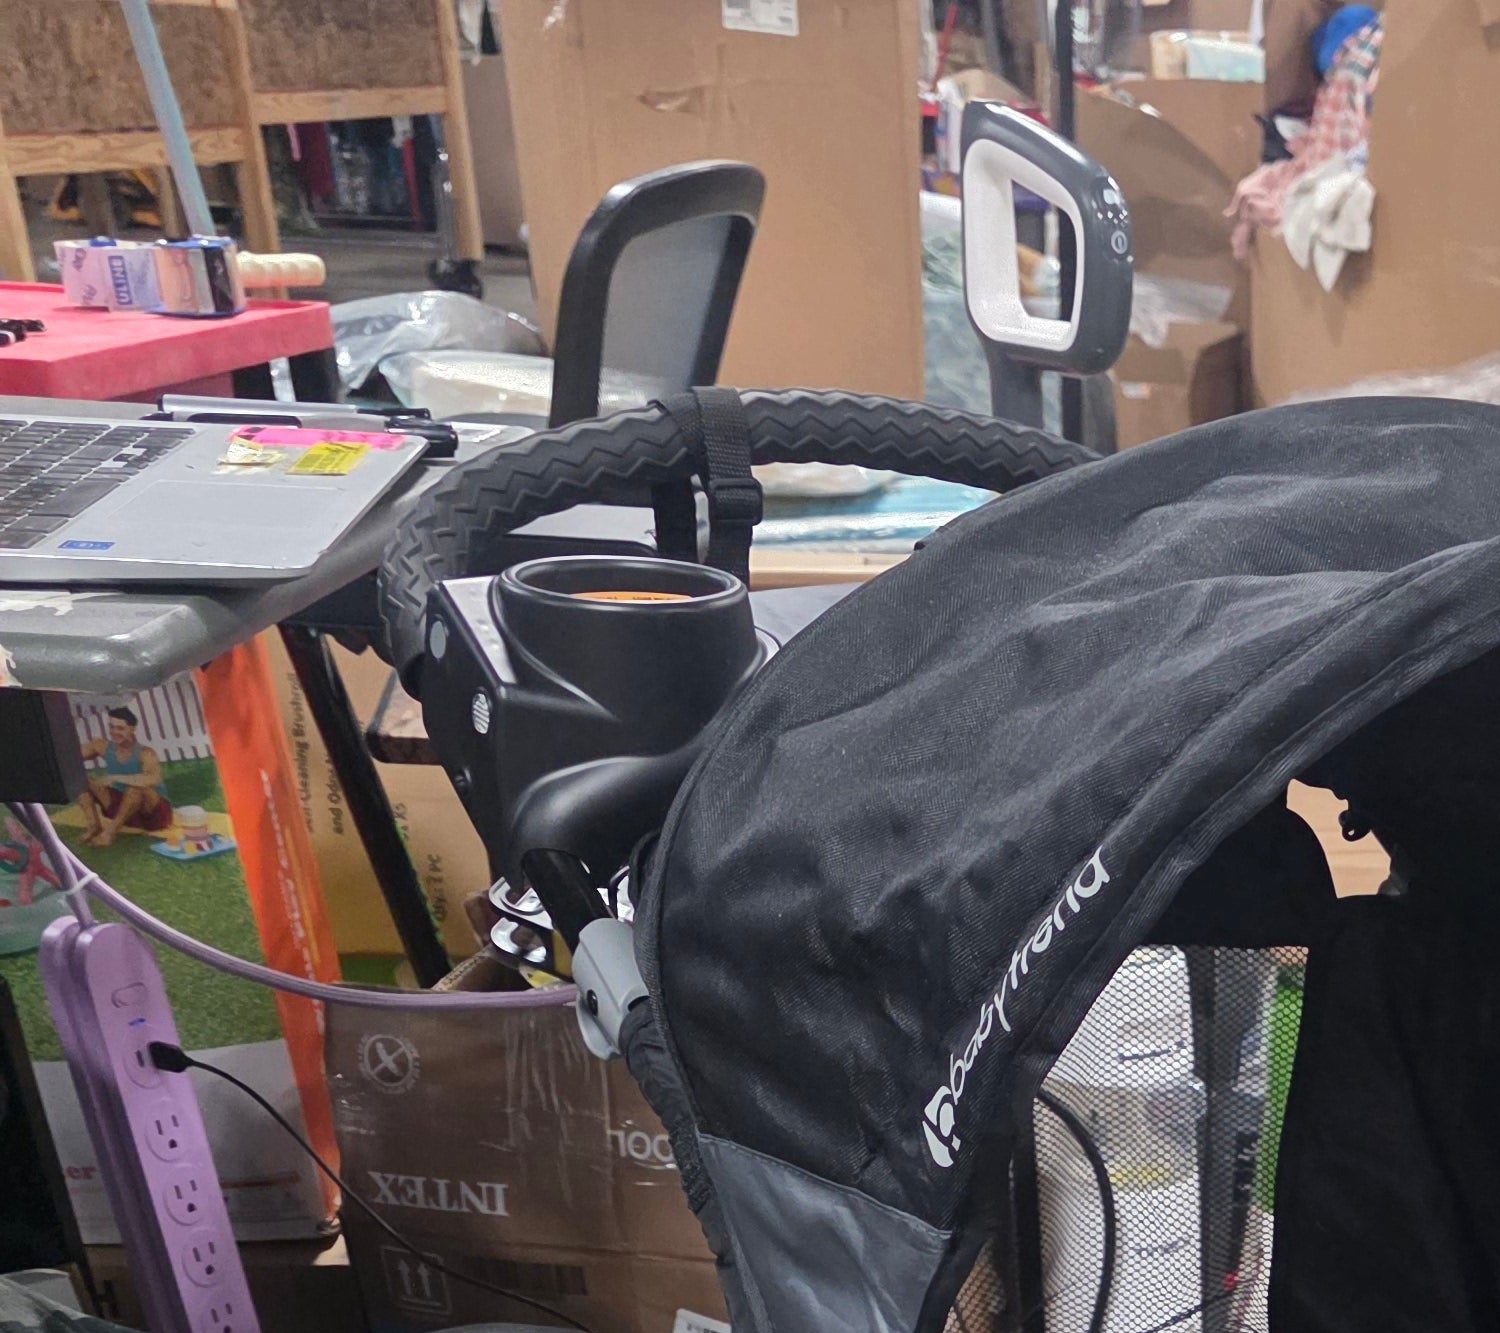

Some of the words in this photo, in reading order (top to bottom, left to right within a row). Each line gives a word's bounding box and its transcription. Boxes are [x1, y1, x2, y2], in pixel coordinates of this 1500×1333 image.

[328, 807, 344, 835] and
[949, 844, 1111, 1106] babytrend
[606, 1130, 676, 1163] OOL
[367, 1170, 508, 1217] INTEX
